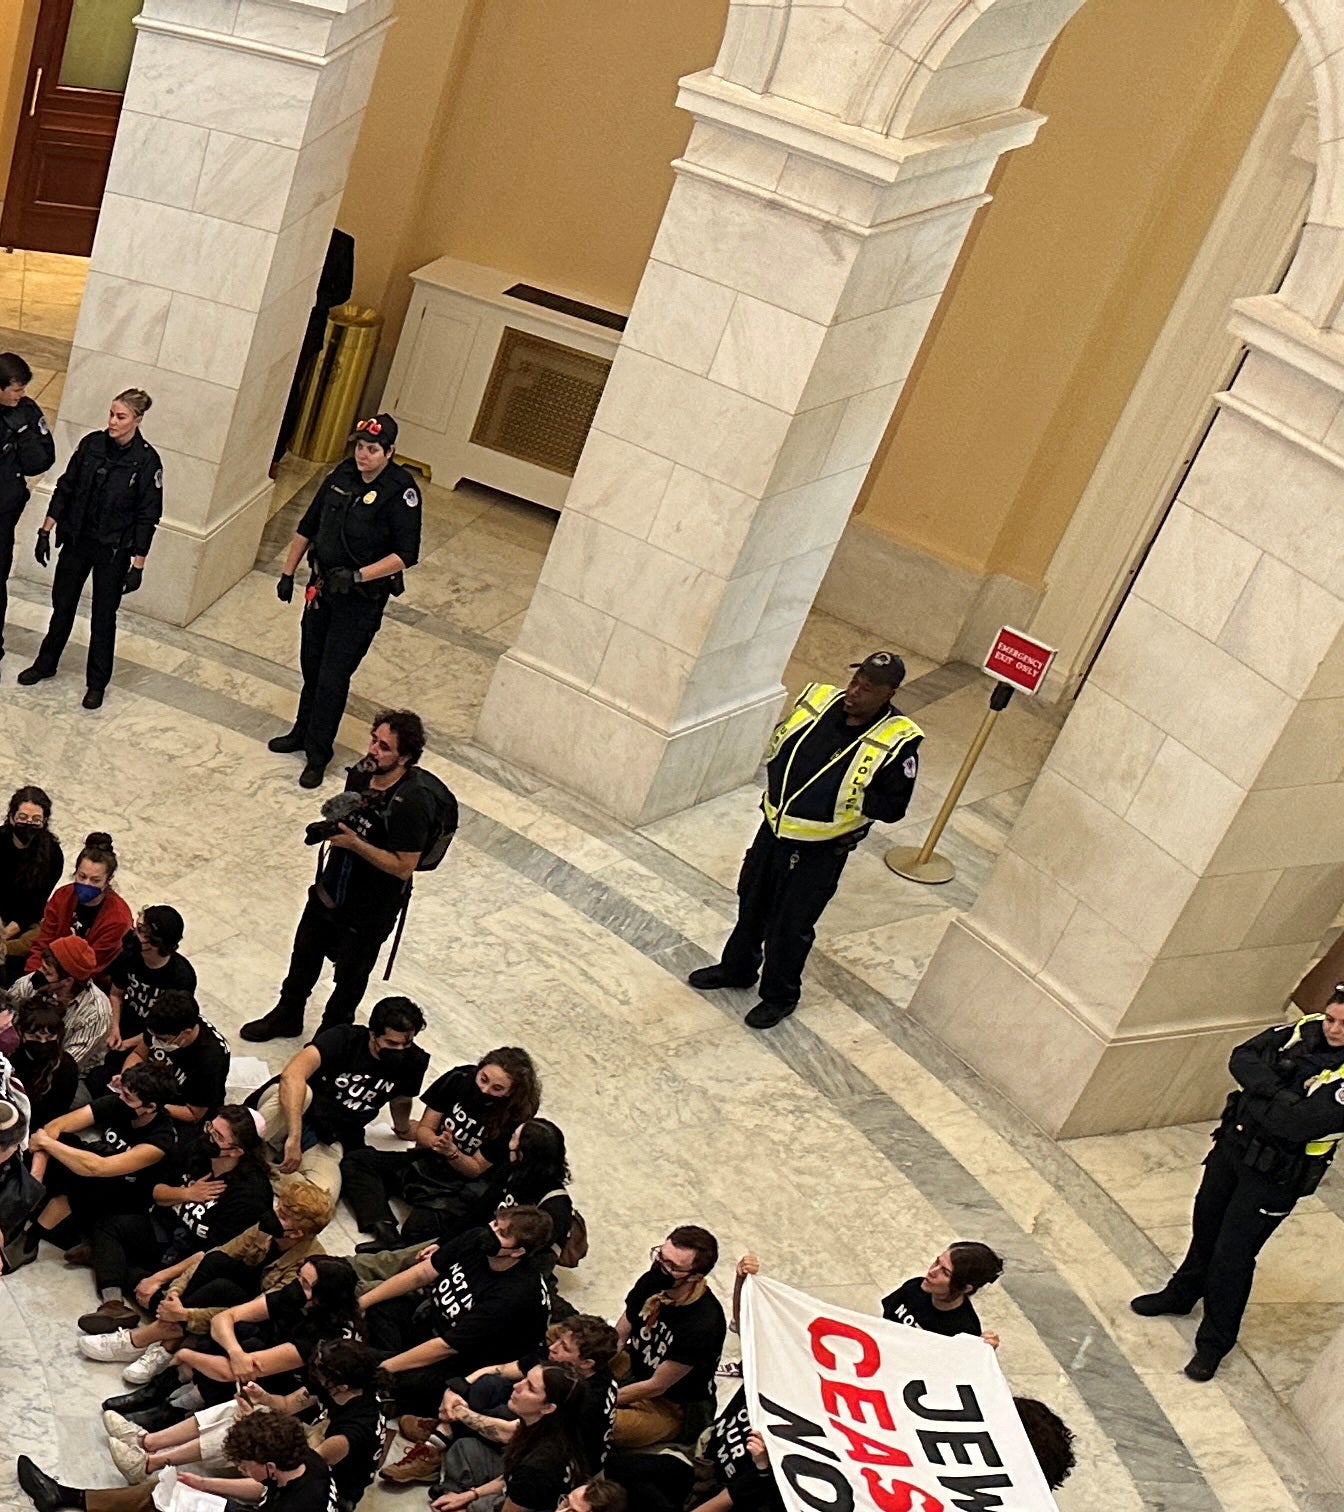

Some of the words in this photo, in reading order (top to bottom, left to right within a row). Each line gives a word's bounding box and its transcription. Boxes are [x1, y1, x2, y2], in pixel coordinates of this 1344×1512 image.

[993, 650, 1015, 665] EXIT
[1016, 661, 1039, 678] ONLY
[997, 641, 1044, 670] EMERGENCY
